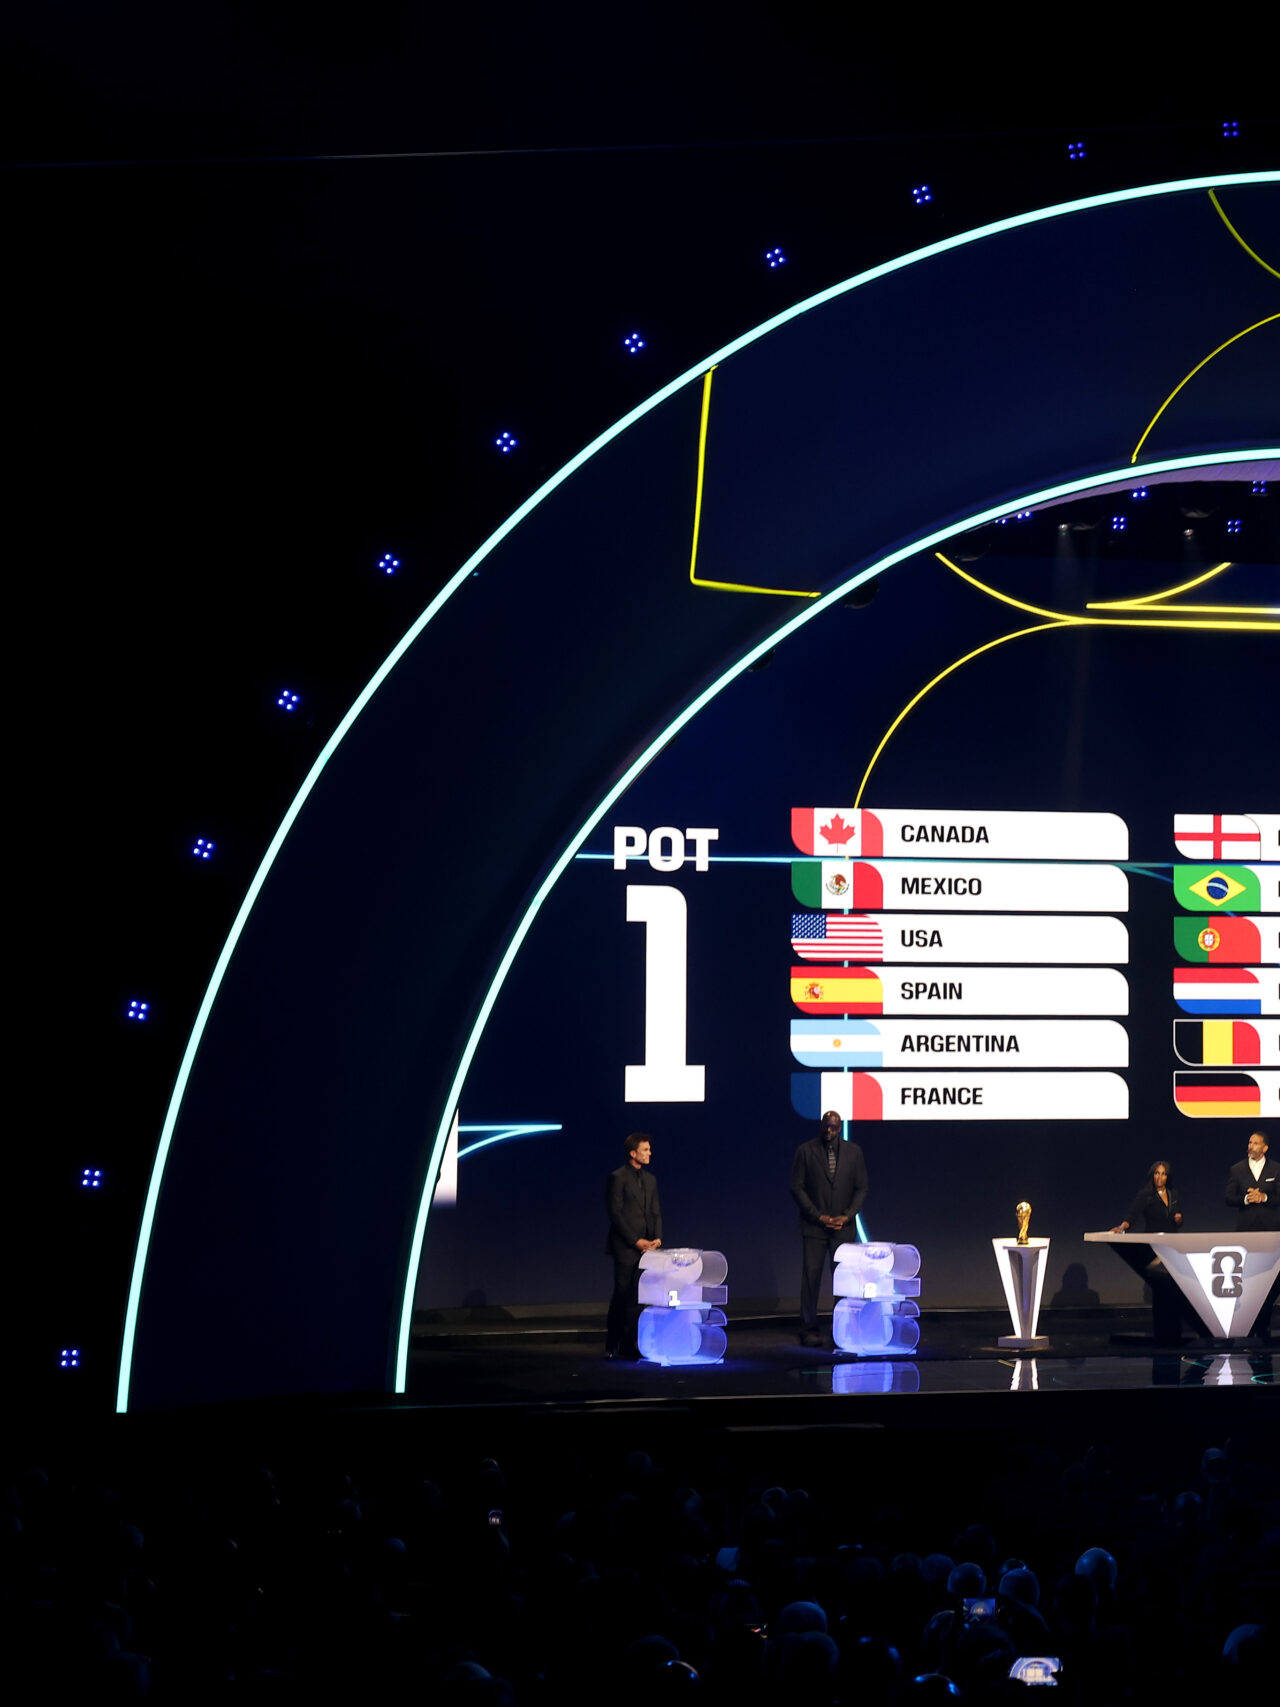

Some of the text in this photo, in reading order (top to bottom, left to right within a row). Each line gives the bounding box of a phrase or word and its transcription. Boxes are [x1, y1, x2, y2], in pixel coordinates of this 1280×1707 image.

[901, 824, 990, 844] CANADA
[613, 825, 719, 872] POT
[901, 877, 982, 896] MEXICO
[900, 929, 943, 948] USA
[624, 884, 705, 1102] 1
[900, 981, 963, 1000] SPAIN
[900, 1034, 1020, 1053] ARGENTINA
[901, 1087, 983, 1106] FRANCE
[668, 1290, 681, 1307] 1
